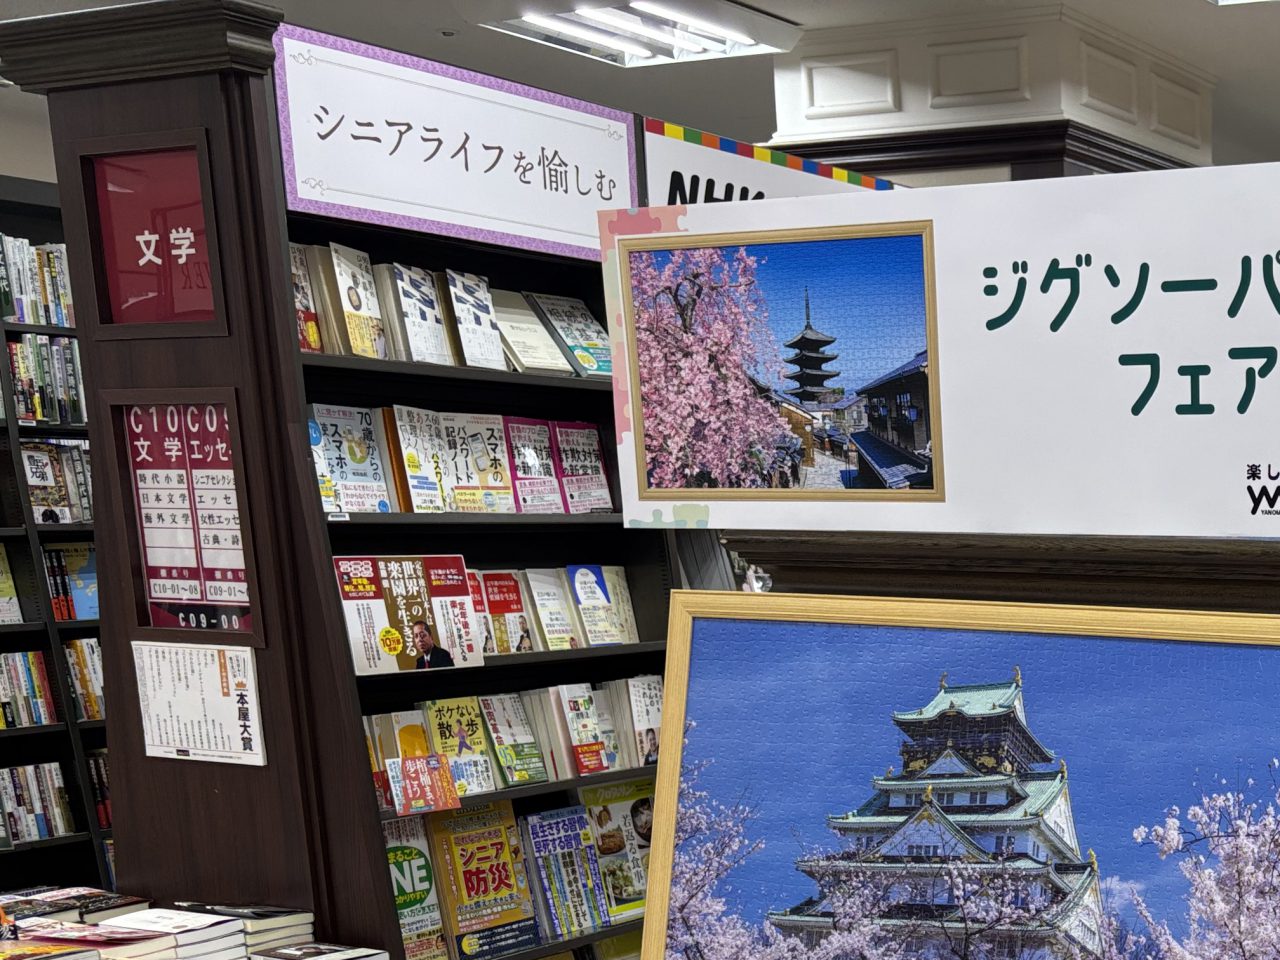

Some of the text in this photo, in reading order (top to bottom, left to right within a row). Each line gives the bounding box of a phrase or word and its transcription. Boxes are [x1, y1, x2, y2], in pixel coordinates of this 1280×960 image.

[313, 105, 617, 201] シニアライフを愉しむ
[135, 226, 197, 267] 文学
[1117, 346, 1279, 417] フェア
[130, 406, 180, 434] C10
[134, 437, 183, 463] 文学
[191, 440, 232, 463] エッセ
[329, 423, 348, 481] スマホの
[485, 427, 504, 483] スマホの
[138, 473, 186, 486] 時代小説
[142, 493, 188, 505] 日本文学
[144, 513, 191, 527] 海外文学
[401, 561, 424, 617] 世界一の
[178, 611, 240, 630] C09-00
[235, 691, 254, 752] 本屋大賞
[435, 704, 476, 720] ボケない
[437, 718, 480, 741] 散歩
[459, 841, 505, 867] シニア
[462, 861, 514, 899] 防災
